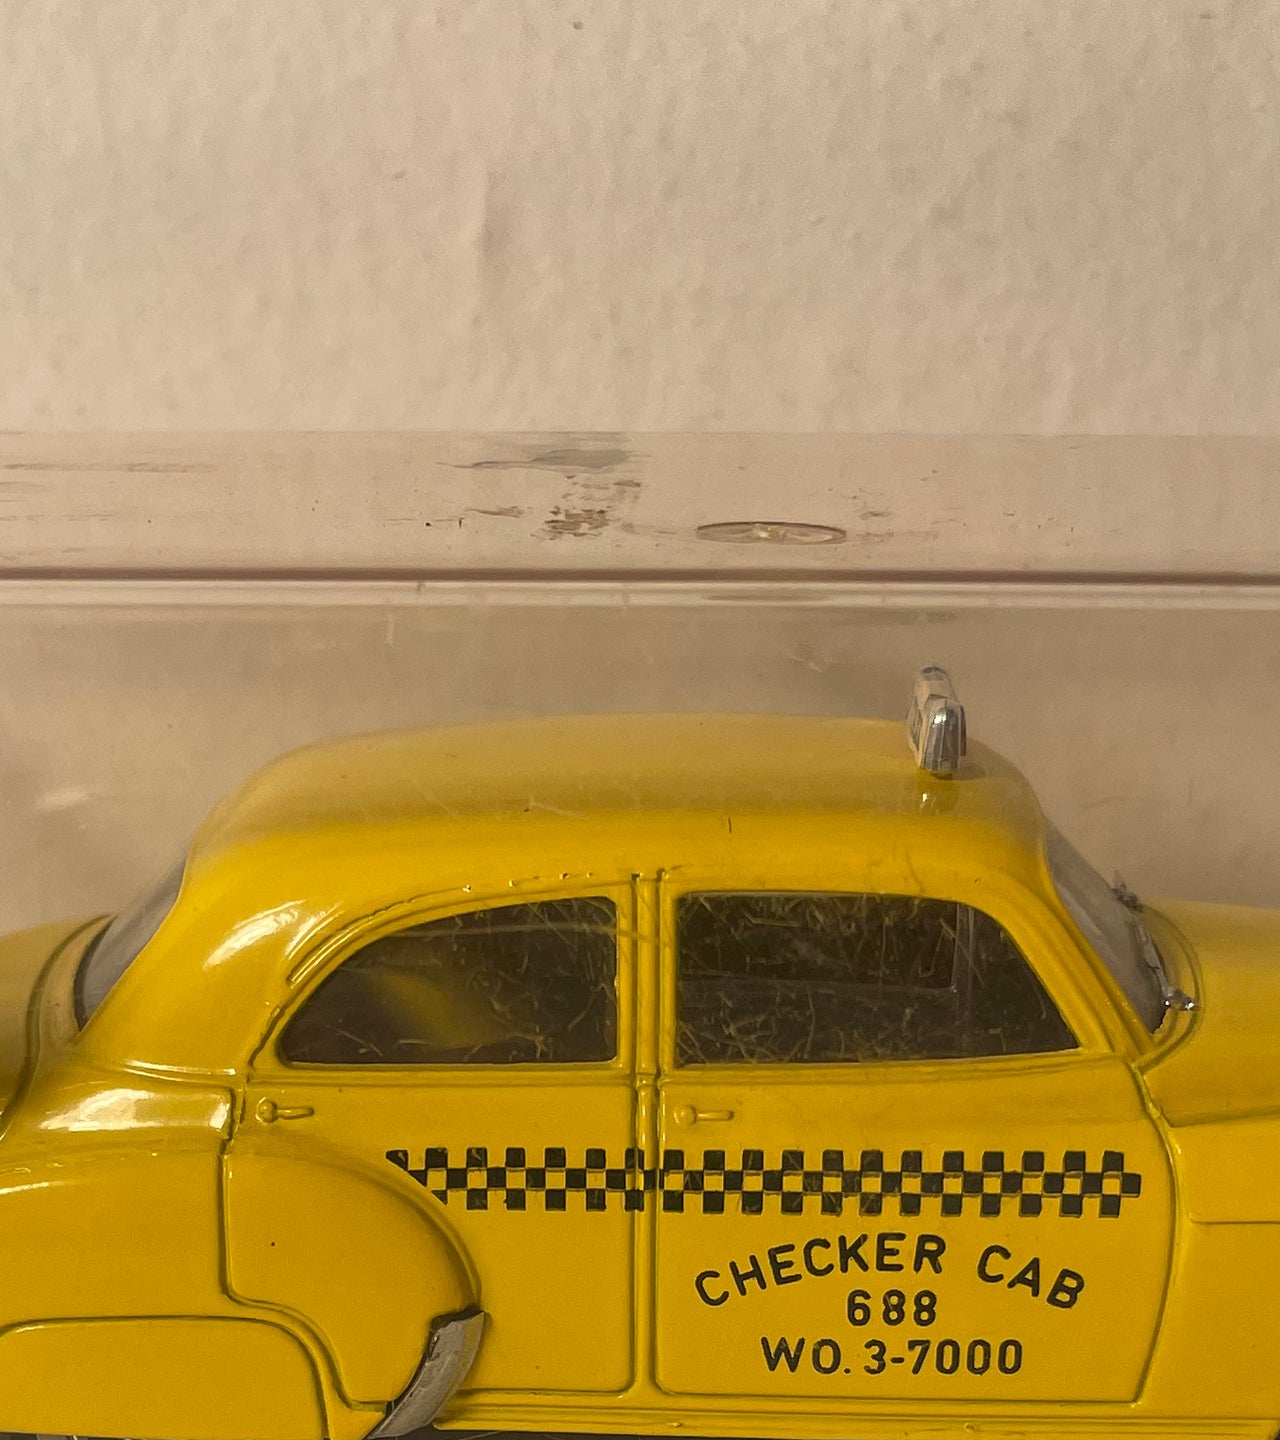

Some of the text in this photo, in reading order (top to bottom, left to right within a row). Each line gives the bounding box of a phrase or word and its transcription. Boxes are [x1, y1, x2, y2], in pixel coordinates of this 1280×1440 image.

[694, 1231, 1086, 1309] CHECKER CAB
[846, 1289, 938, 1327] 688
